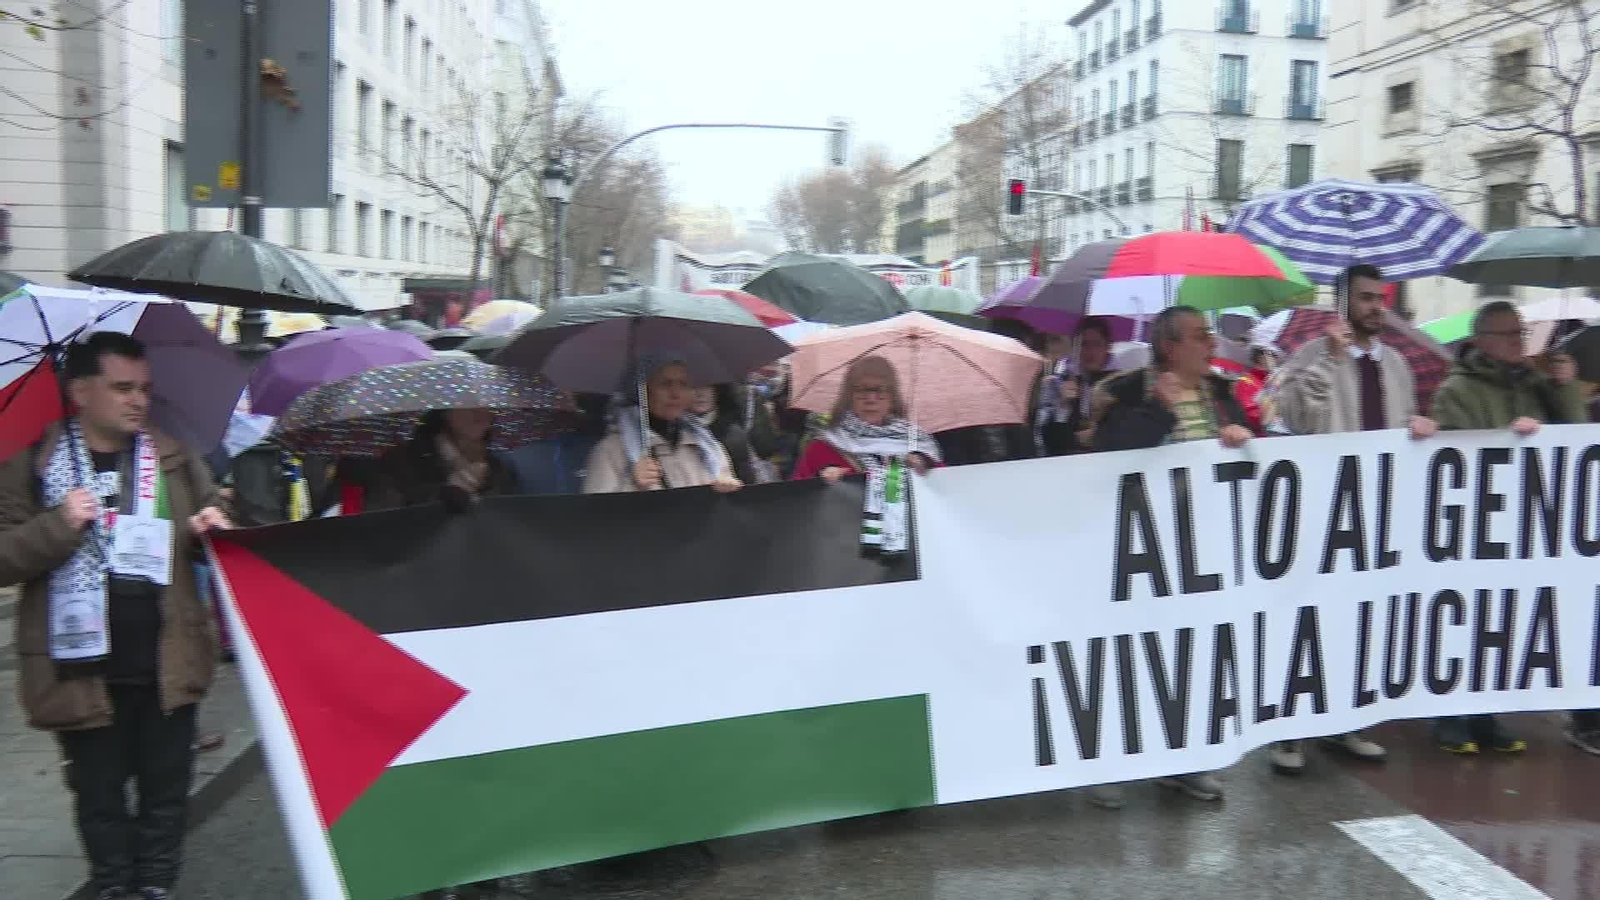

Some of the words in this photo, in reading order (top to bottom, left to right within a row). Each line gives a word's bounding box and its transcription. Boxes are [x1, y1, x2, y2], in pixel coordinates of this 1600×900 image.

[1112, 459, 1302, 602] ALTO
[1318, 452, 1402, 574] AL
[1352, 586, 1563, 708] LUCHA
